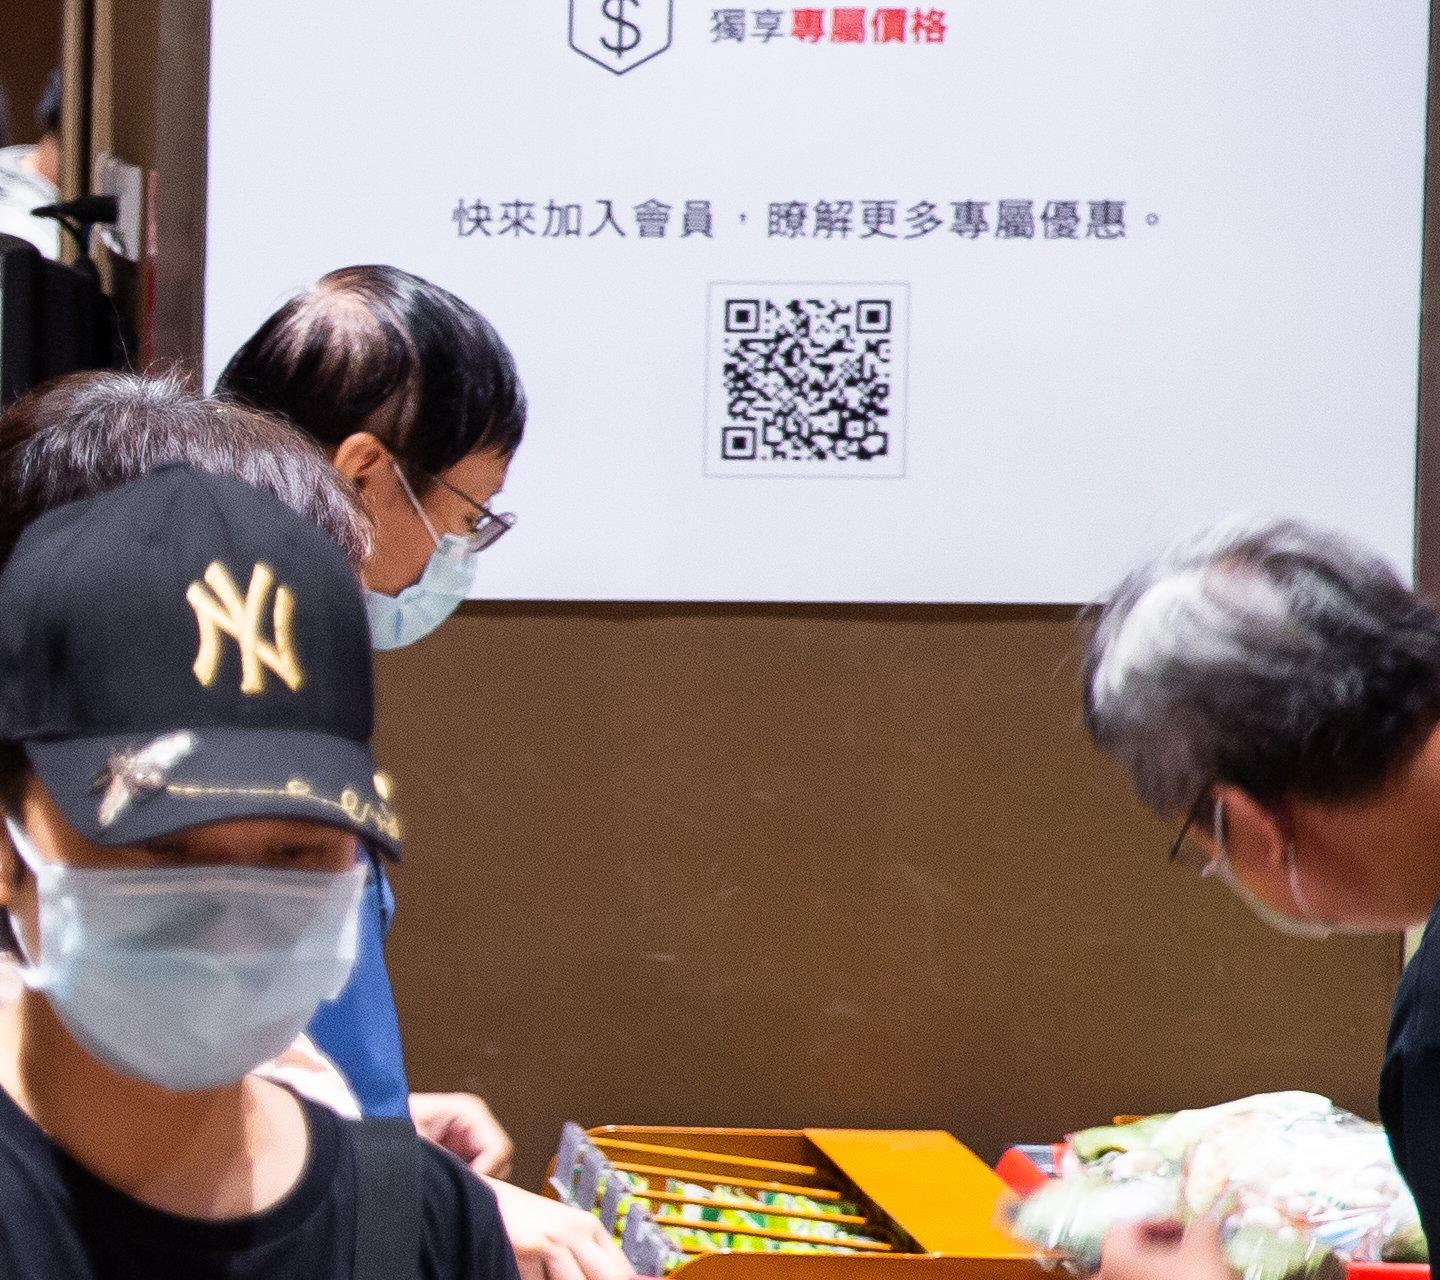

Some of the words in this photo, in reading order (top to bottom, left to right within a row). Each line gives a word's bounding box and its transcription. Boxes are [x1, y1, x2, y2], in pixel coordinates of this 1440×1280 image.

[710, 6, 949, 45] 獨享專屬價格
